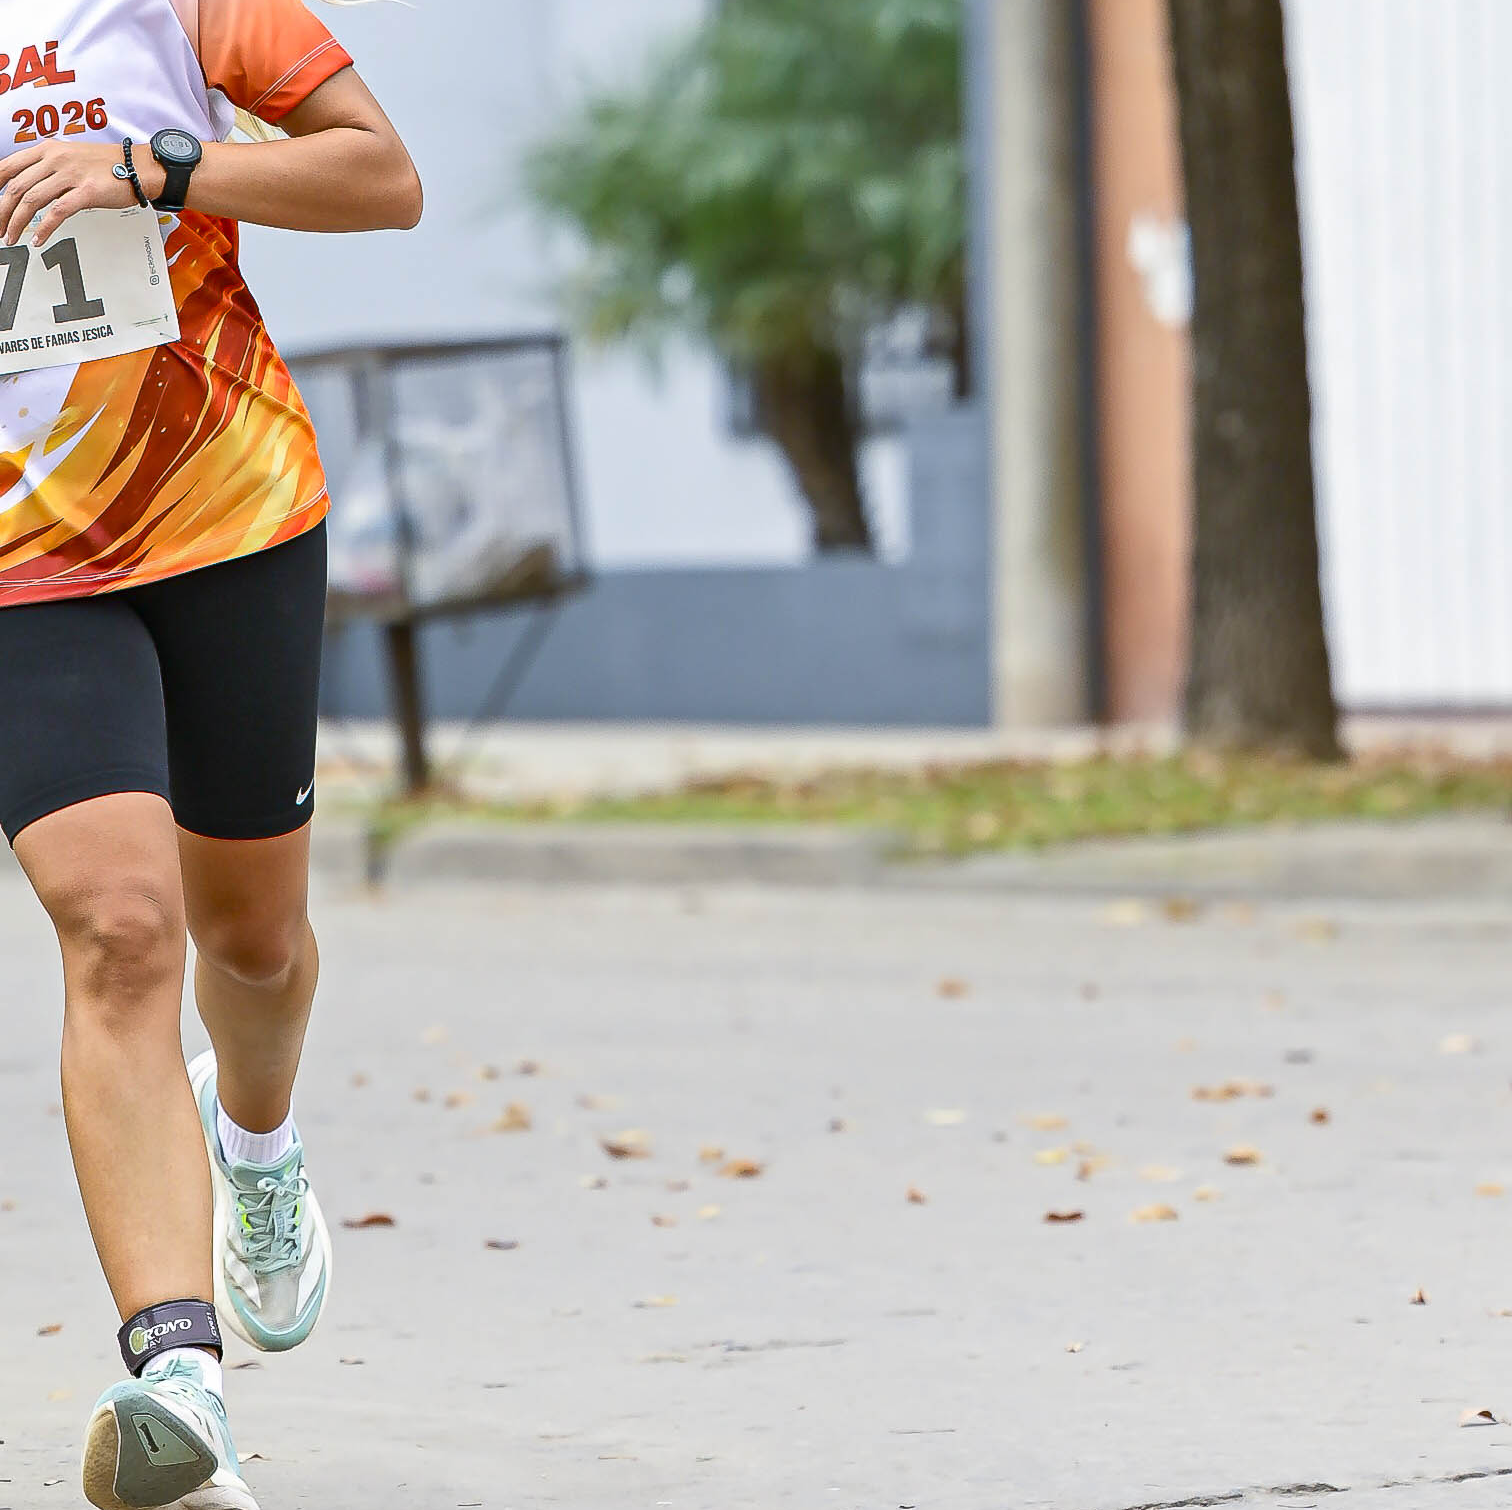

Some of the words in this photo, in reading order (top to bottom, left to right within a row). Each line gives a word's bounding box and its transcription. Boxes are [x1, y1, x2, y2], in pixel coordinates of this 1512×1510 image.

[11, 97, 108, 144] 2026
[30, 336, 45, 350] DE
[45, 330, 80, 348] FARIAS
[81, 324, 114, 342] JESICA
